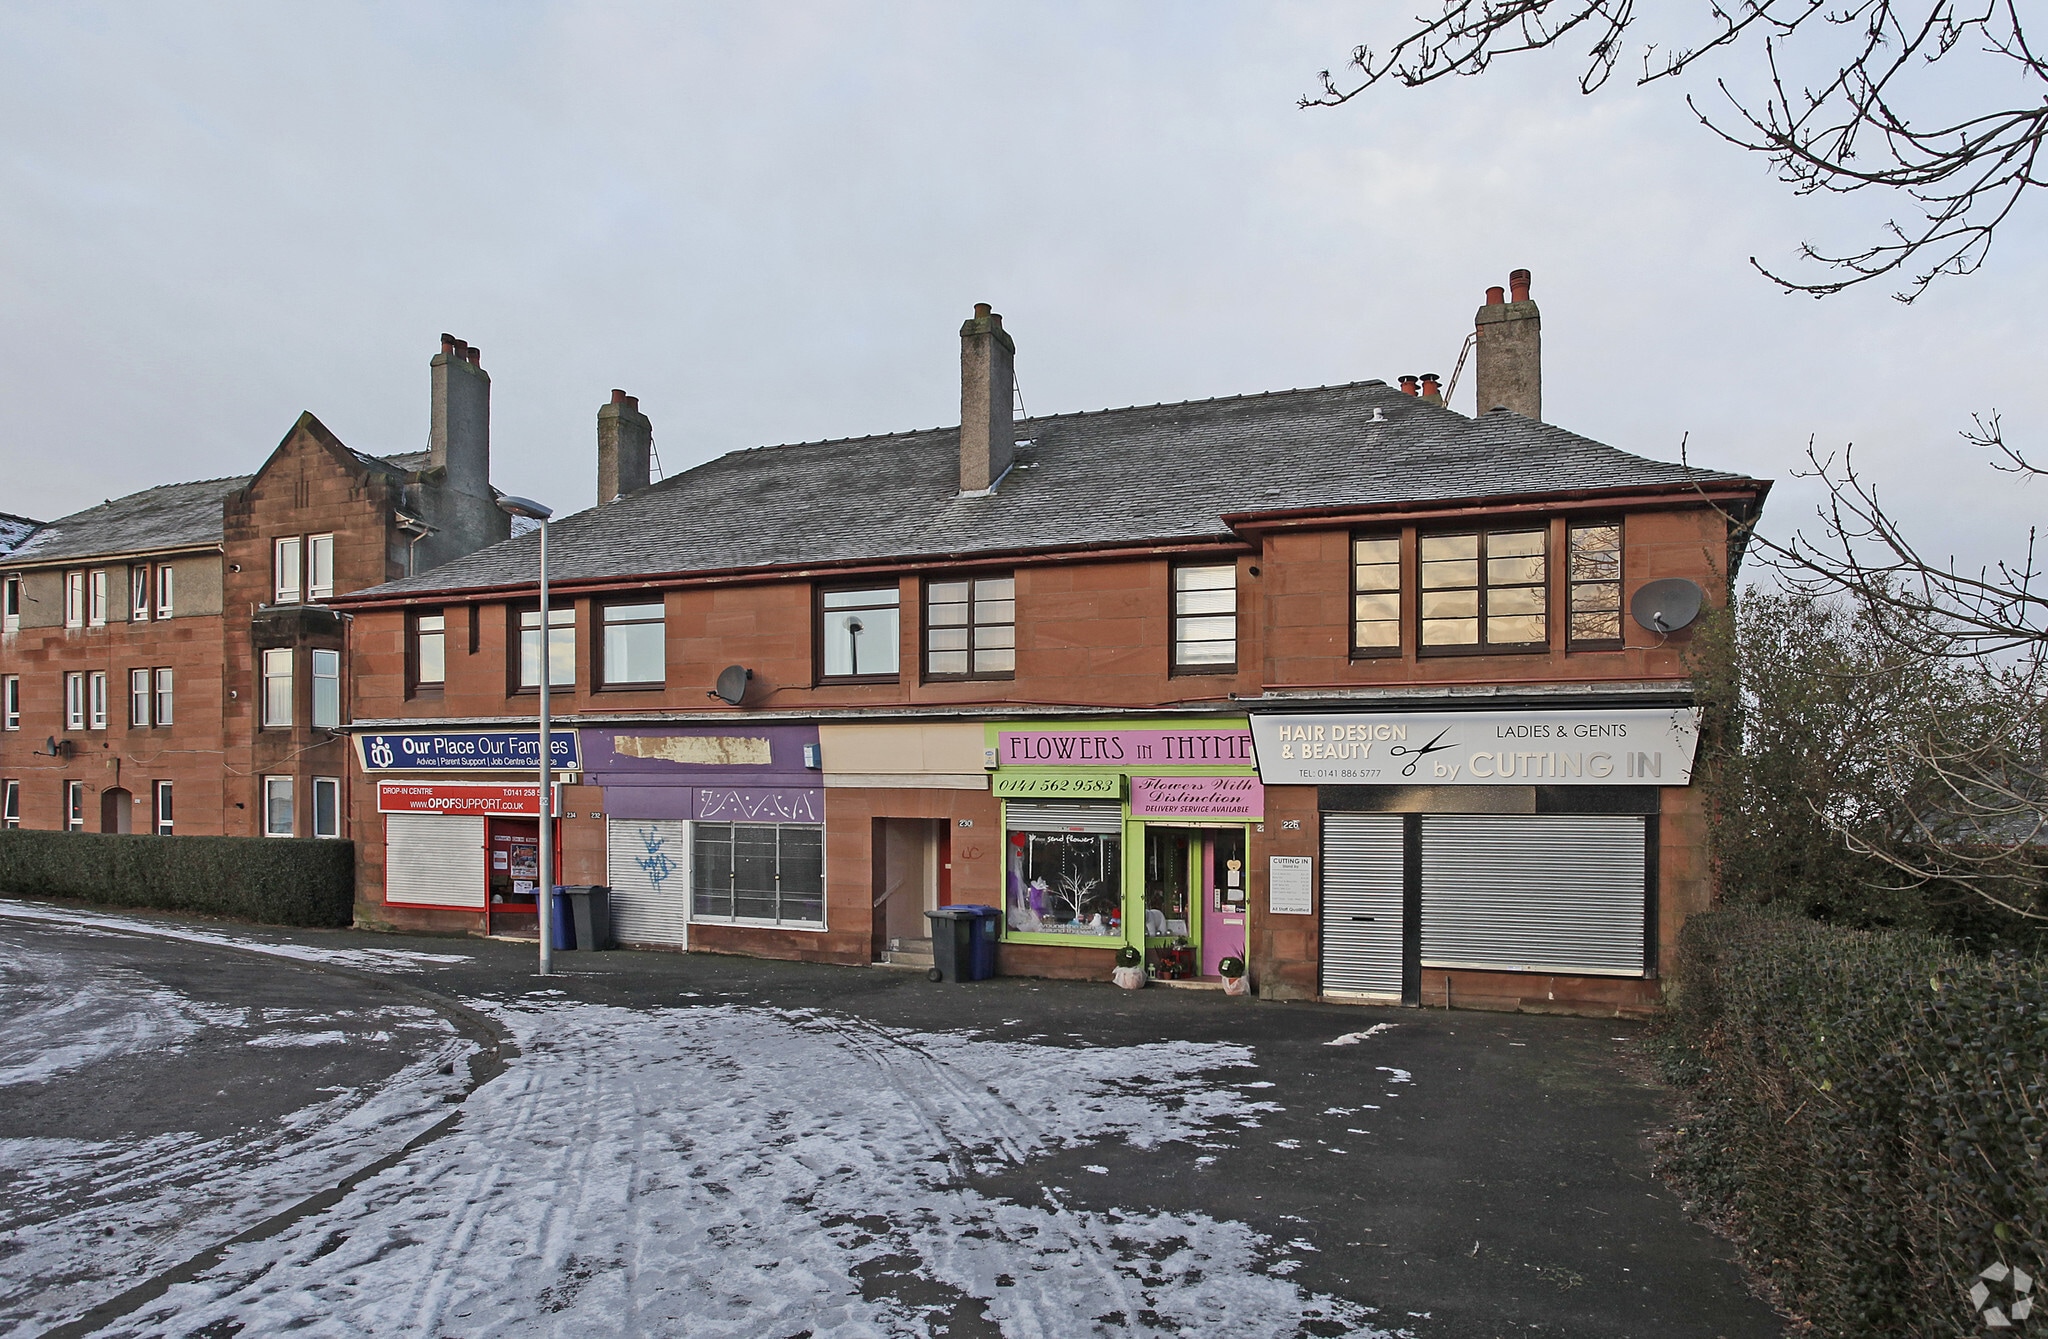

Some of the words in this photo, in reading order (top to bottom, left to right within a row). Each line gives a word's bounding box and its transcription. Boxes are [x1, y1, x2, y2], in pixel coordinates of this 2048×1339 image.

[1279, 725, 1326, 742] HAIR
[1332, 724, 1408, 742] DESIGN
[1496, 725, 1550, 738] LADIES
[1556, 725, 1568, 738] &
[1573, 724, 1627, 738] GENTS
[402, 737, 430, 754] Our
[435, 737, 474, 754] Place
[478, 737, 504, 754] Our
[509, 737, 568, 754] Fames
[1010, 736, 1124, 760] FLOWERS
[1162, 736, 1251, 759] THYME
[1281, 743, 1295, 760] &
[1302, 743, 1373, 760] BEAUTY
[416, 757, 436, 765] Advice
[441, 757, 460, 766] Parent
[462, 757, 486, 767] Support
[491, 757, 502, 766] Job
[504, 757, 525, 766] Centre
[1433, 760, 1461, 781] by
[1469, 751, 1615, 778] CUTTING
[1626, 751, 1662, 778] IN
[1299, 769, 1316, 777] TEL:
[1317, 769, 1338, 777] 0141
[1341, 769, 1357, 778] 886
[1360, 769, 1382, 778] 5777
[999, 780, 1037, 792] 0141
[1040, 780, 1068, 792] 562
[1072, 780, 1114, 792] 9583
[1139, 777, 1204, 791] Flowers
[1211, 777, 1254, 791] With
[383, 787, 408, 795] DROP-IN
[409, 787, 433, 795] CENTRE
[1148, 790, 1245, 803] Distinction
[1180, 805, 1209, 813] SERVICE
[1283, 820, 1300, 830] 226
[1047, 835, 1064, 843] send
[1066, 835, 1095, 844] flowers
